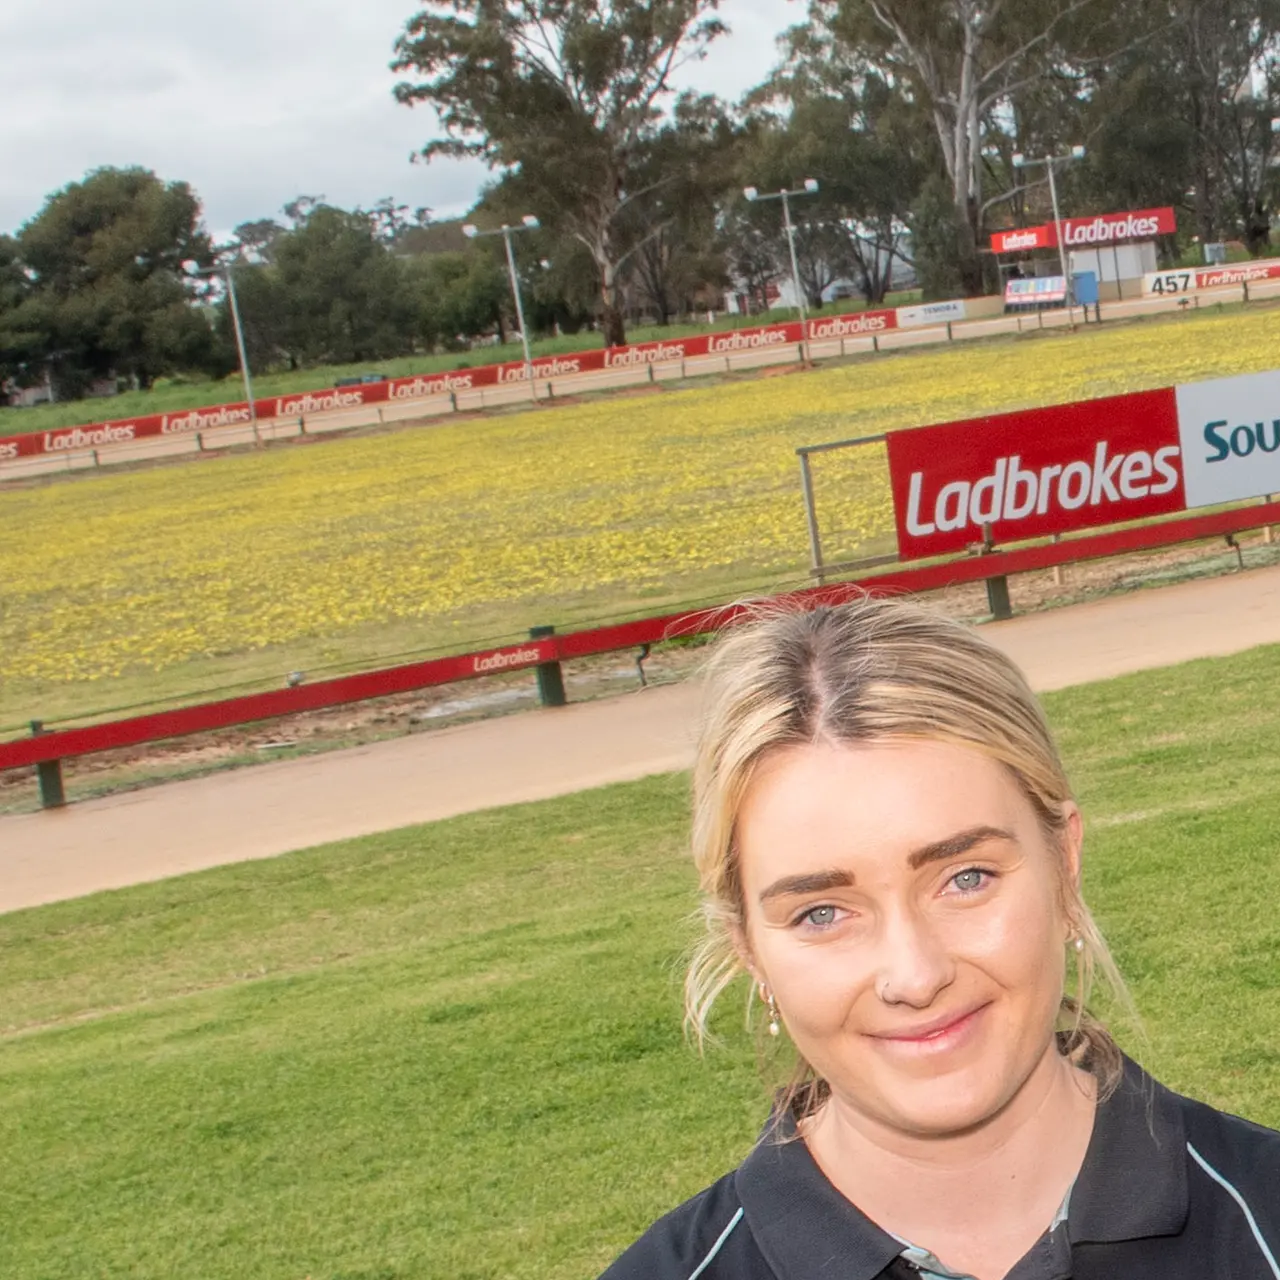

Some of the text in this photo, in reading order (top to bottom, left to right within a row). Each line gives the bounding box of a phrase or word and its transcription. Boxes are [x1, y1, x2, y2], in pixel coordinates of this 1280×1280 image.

[1064, 214, 1158, 245] Ladbrokes
[1151, 273, 1191, 295] 457
[808, 312, 887, 340] Ladbrokes
[707, 328, 787, 353] Ladbrokes
[604, 342, 685, 369] Ladbrokes
[497, 357, 581, 385] Ladbrokes
[388, 371, 473, 401] Ladbrokes
[275, 389, 364, 418] Ladbrokes
[161, 404, 250, 434] Ladbrokes
[44, 421, 135, 452] Ladbrokes
[905, 440, 1181, 537] Ladbrokes
[474, 648, 540, 671] Ladbrokes
